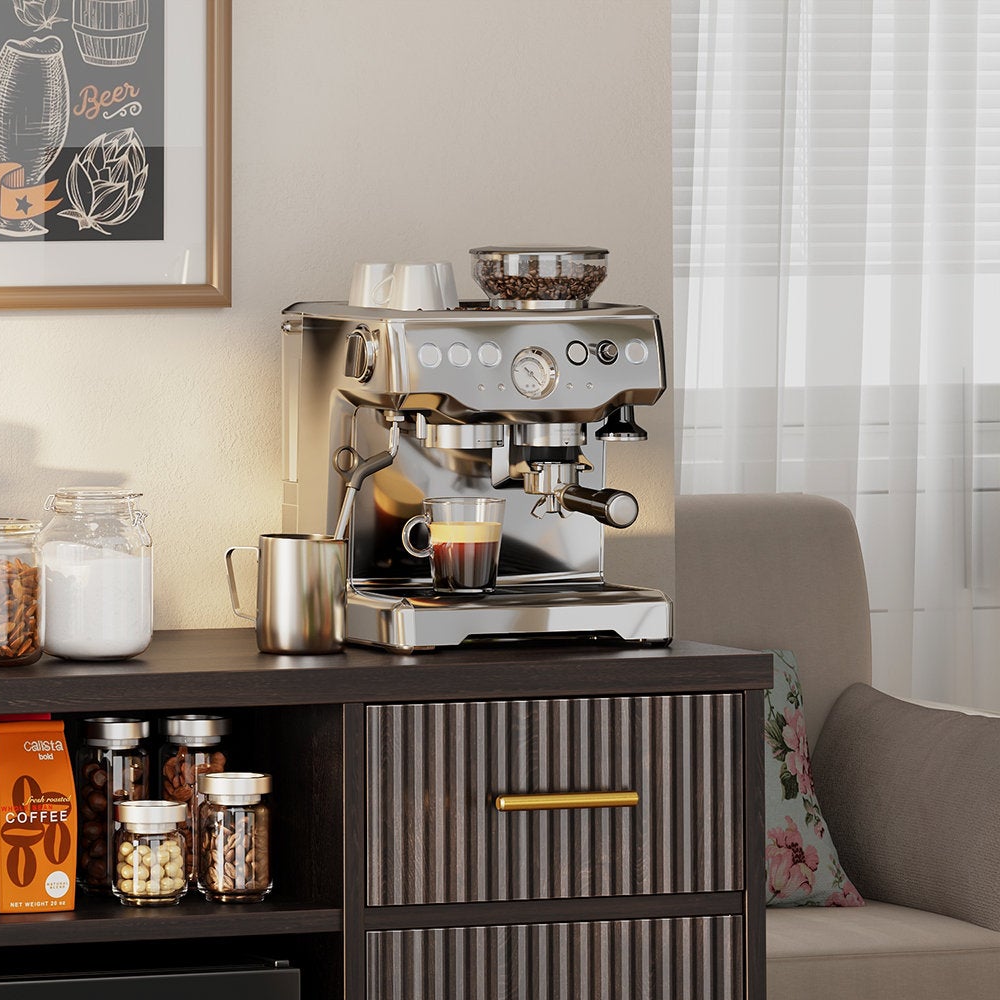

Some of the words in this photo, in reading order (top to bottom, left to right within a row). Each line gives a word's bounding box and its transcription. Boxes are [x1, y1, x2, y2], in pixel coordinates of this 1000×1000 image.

[73, 82, 140, 120] Beer
[37, 753, 55, 761] bold
[22, 795, 45, 807] fresh
[46, 795, 72, 804] roasted
[5, 810, 68, 824] COFFEE
